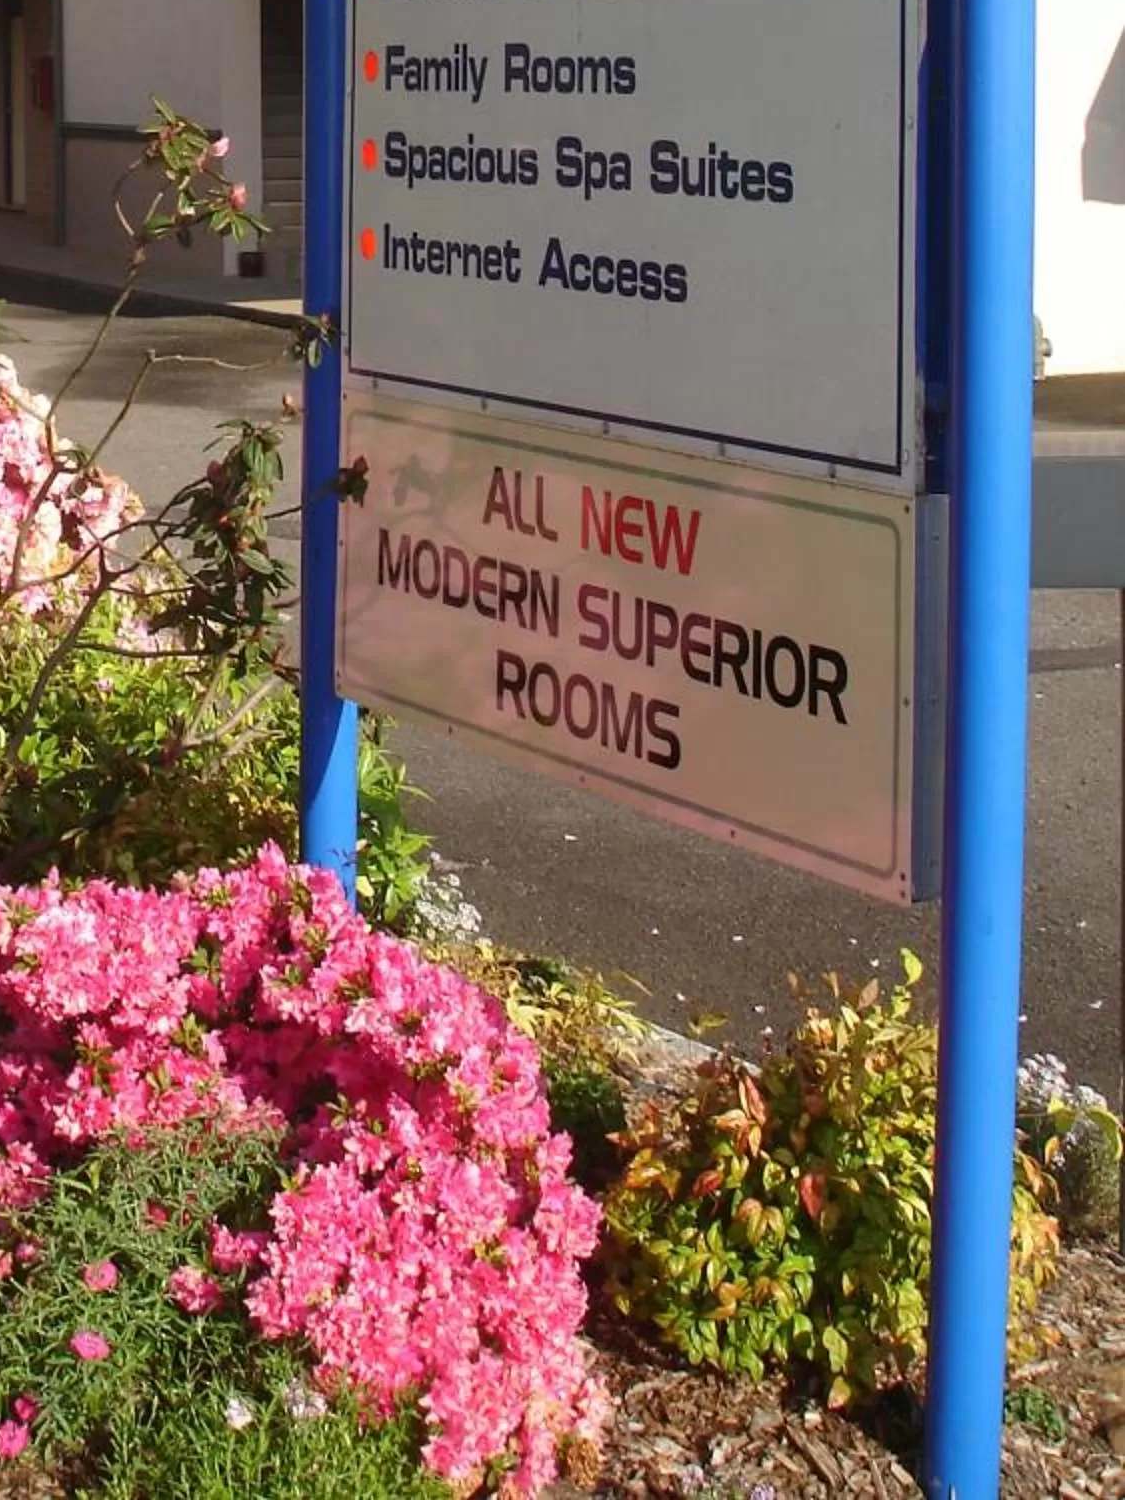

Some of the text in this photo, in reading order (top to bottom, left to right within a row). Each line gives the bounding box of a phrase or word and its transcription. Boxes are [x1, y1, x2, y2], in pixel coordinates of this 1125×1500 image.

[384, 43, 636, 102] Family Rooms
[384, 132, 794, 203] Spacious Spa Suites
[383, 223, 688, 303] Internet Access
[483, 466, 701, 576] ALL NEW
[377, 528, 848, 725] MODERN SUPERIOR
[496, 649, 681, 771] ROOMS
